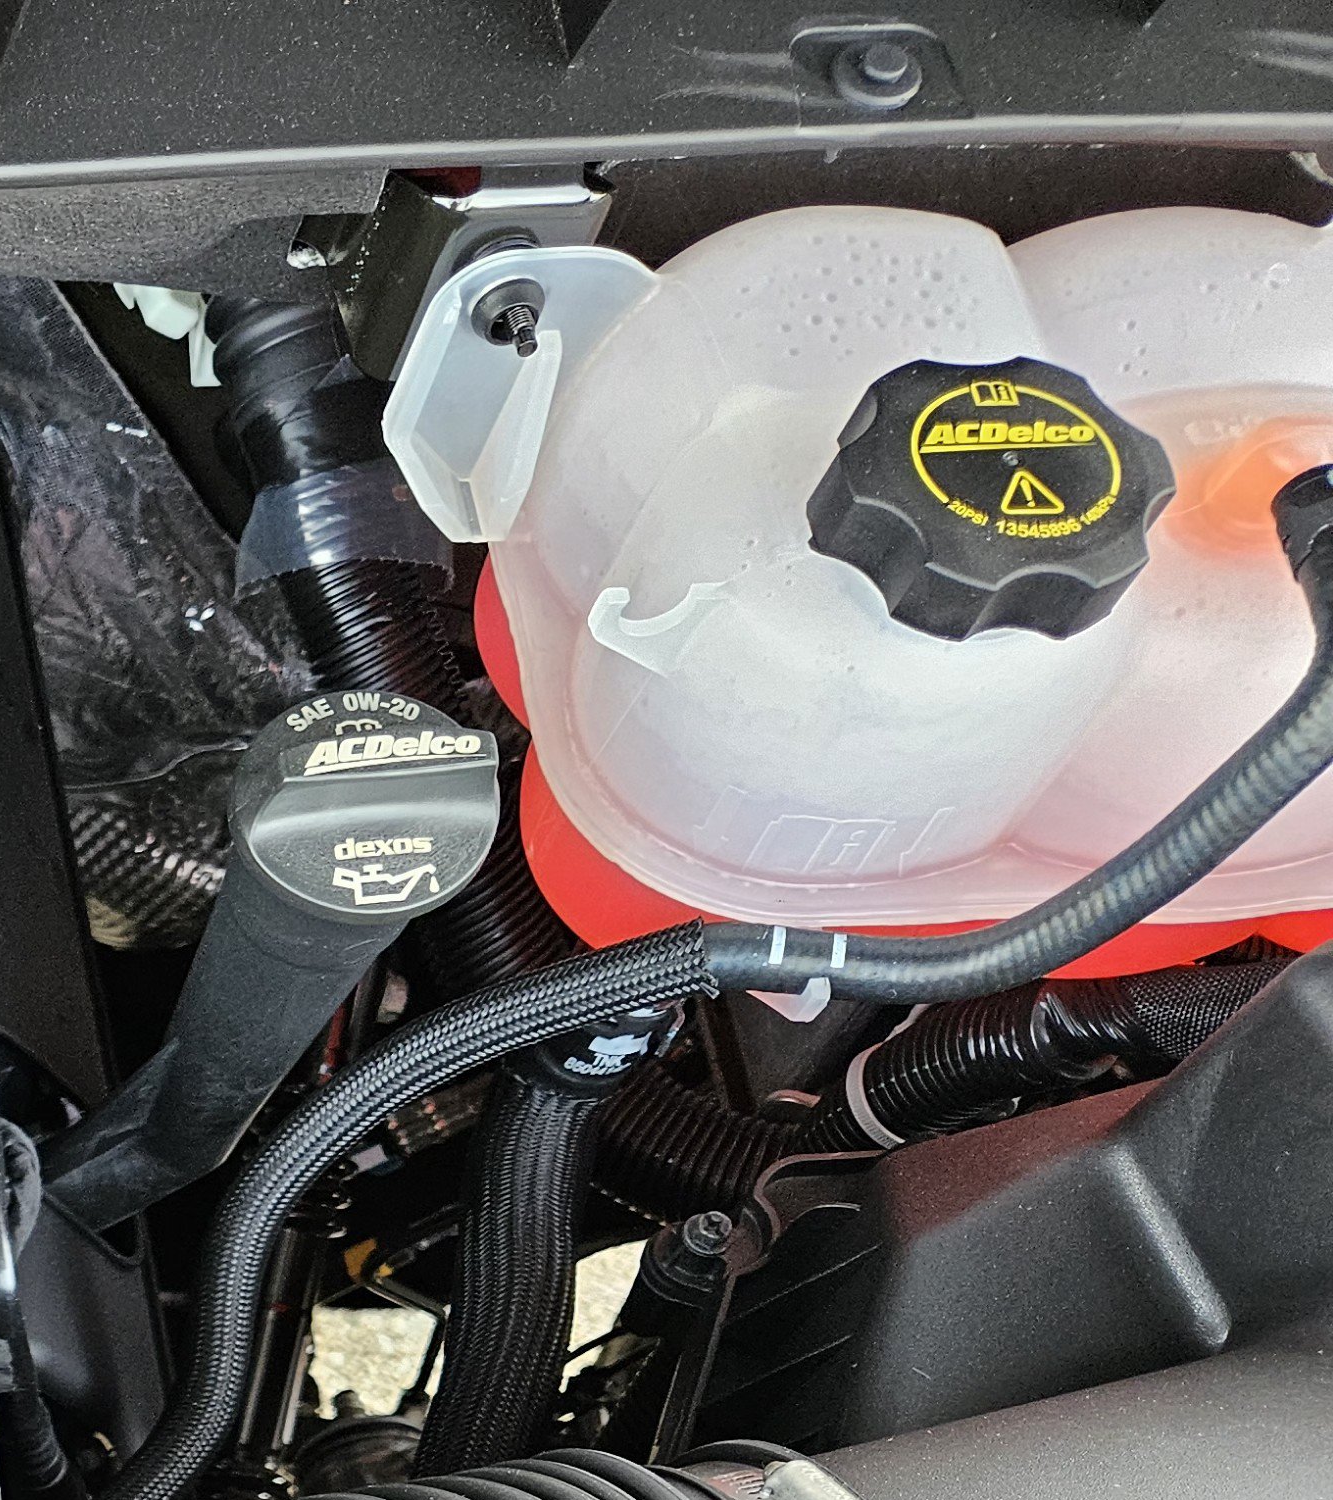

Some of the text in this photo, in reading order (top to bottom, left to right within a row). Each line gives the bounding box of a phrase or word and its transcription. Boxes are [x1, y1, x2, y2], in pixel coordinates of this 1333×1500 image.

[924, 421, 1095, 445] ACDelco
[947, 500, 989, 527] 20PSI
[995, 518, 1082, 539] 13545896
[286, 692, 420, 732] SAE 0W-20
[305, 731, 481, 768] ACDelco
[334, 837, 434, 860] dexos
